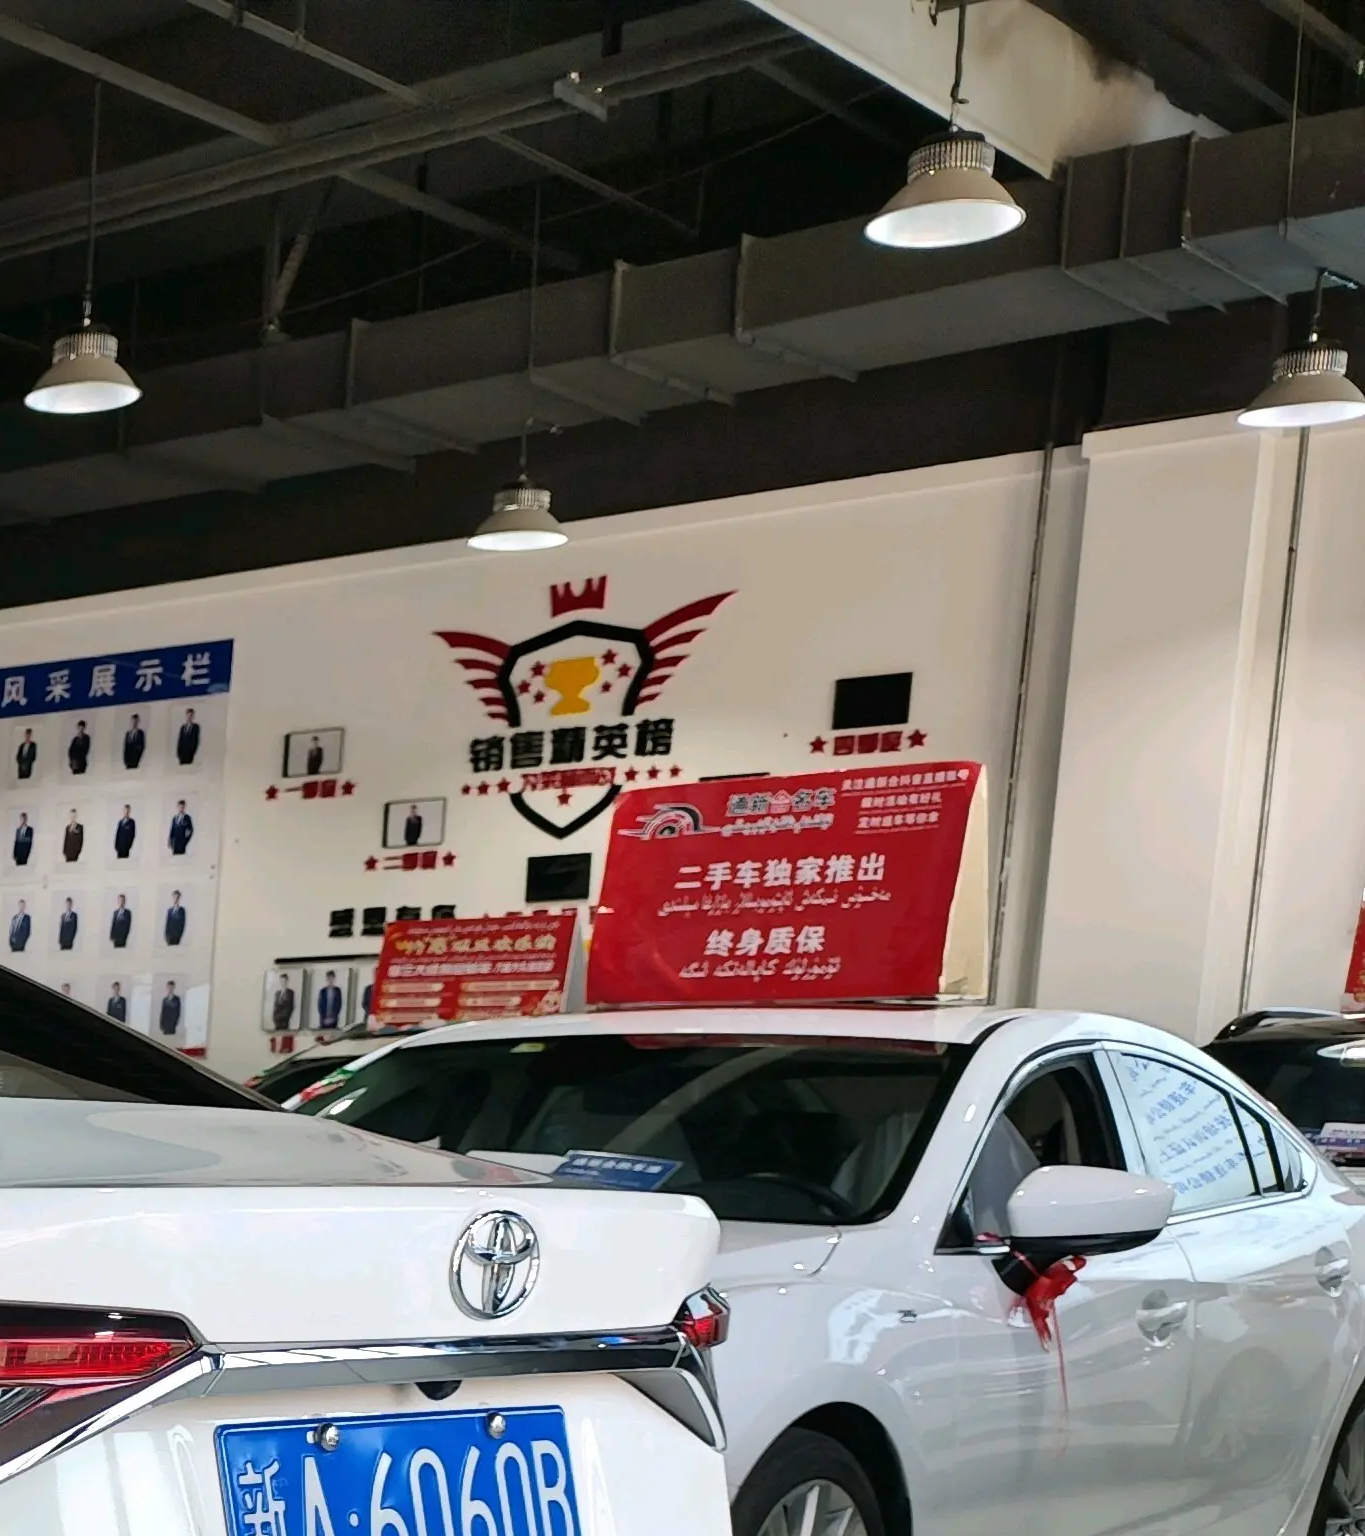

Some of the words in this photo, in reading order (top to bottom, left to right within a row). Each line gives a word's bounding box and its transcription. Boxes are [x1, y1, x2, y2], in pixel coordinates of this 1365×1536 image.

[673, 853, 886, 891] 二手车独家推出
[703, 925, 826, 957] 终身质保
